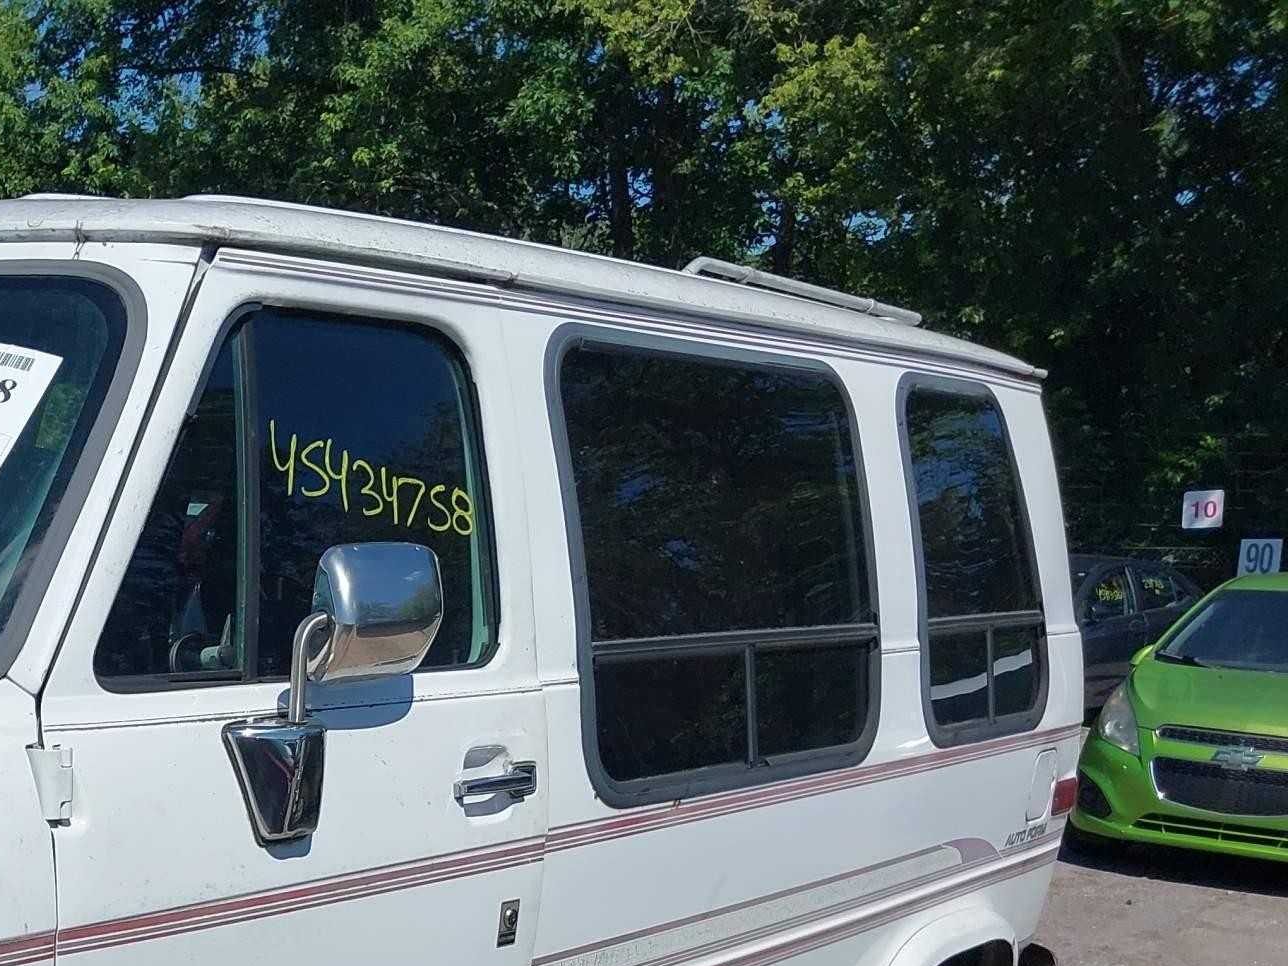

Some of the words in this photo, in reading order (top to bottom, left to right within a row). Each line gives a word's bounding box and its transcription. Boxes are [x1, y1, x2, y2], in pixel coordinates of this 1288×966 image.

[269, 418, 473, 536] 45434758
[1191, 500, 1217, 519] 10
[1244, 542, 1274, 574] 90
